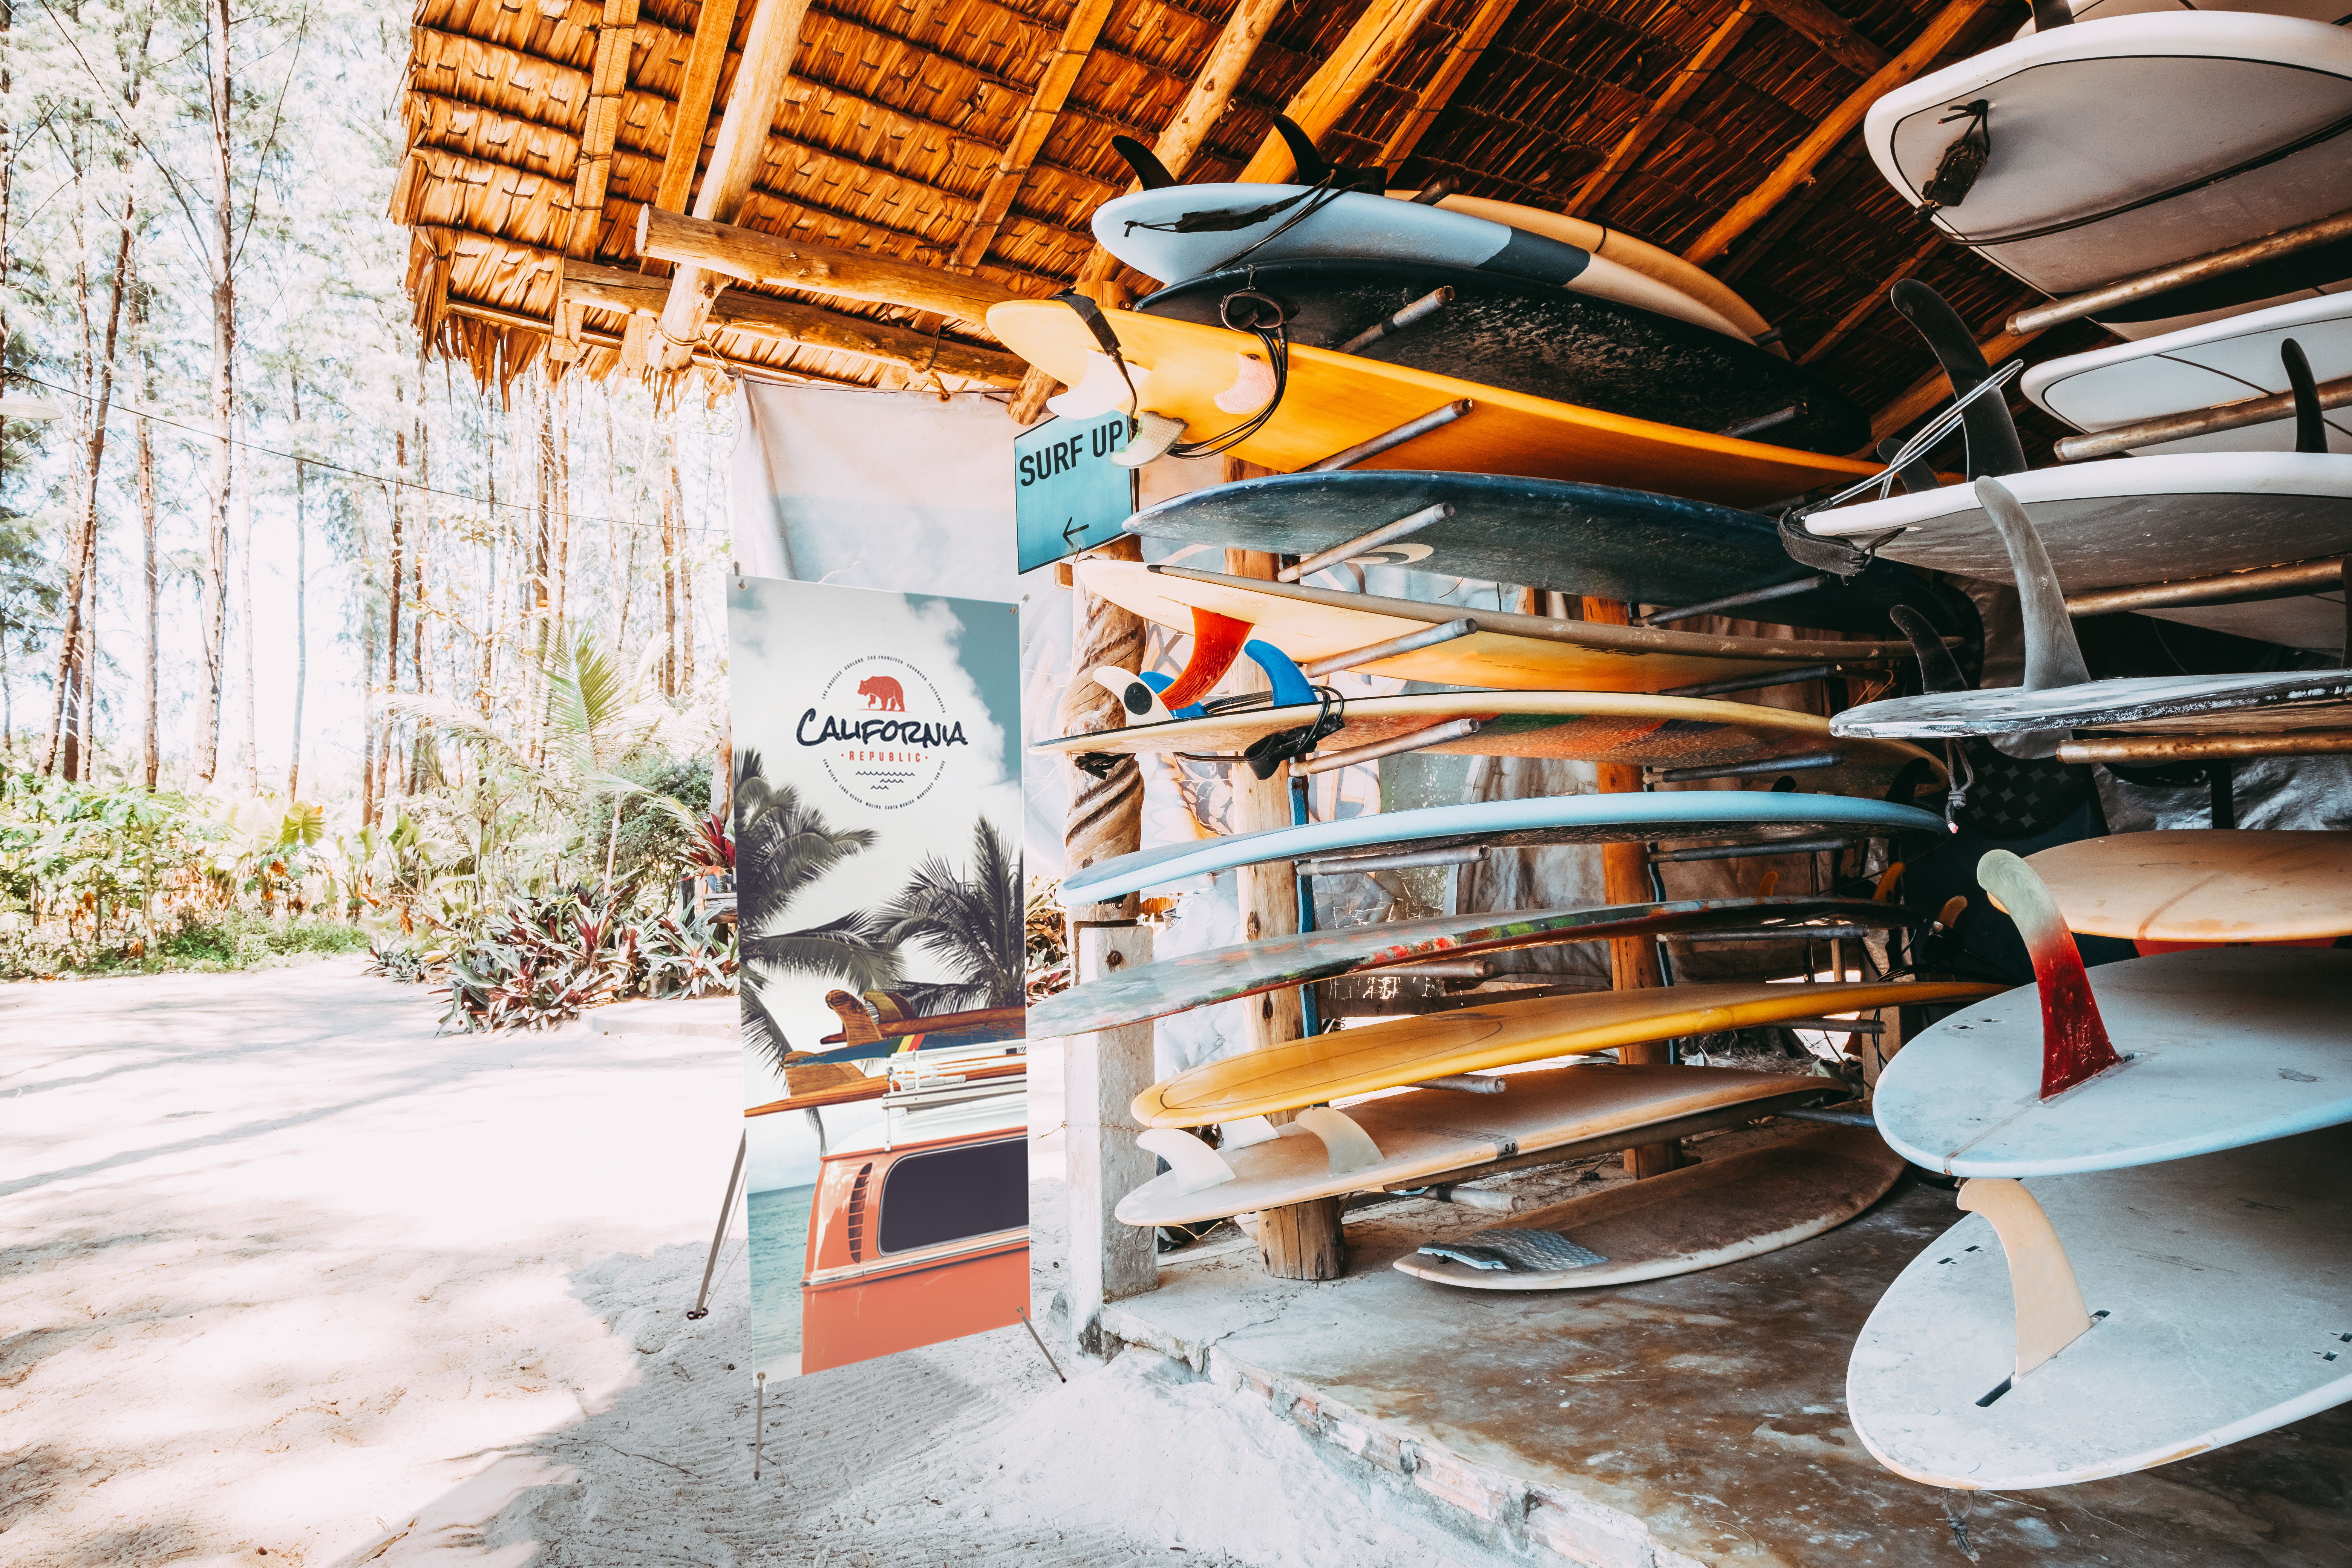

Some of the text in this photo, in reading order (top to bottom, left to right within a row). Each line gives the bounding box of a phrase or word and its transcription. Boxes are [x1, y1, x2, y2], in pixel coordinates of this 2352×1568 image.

[1019, 420, 1123, 486] SURF UP
[849, 751, 920, 762] REPUBLIC
